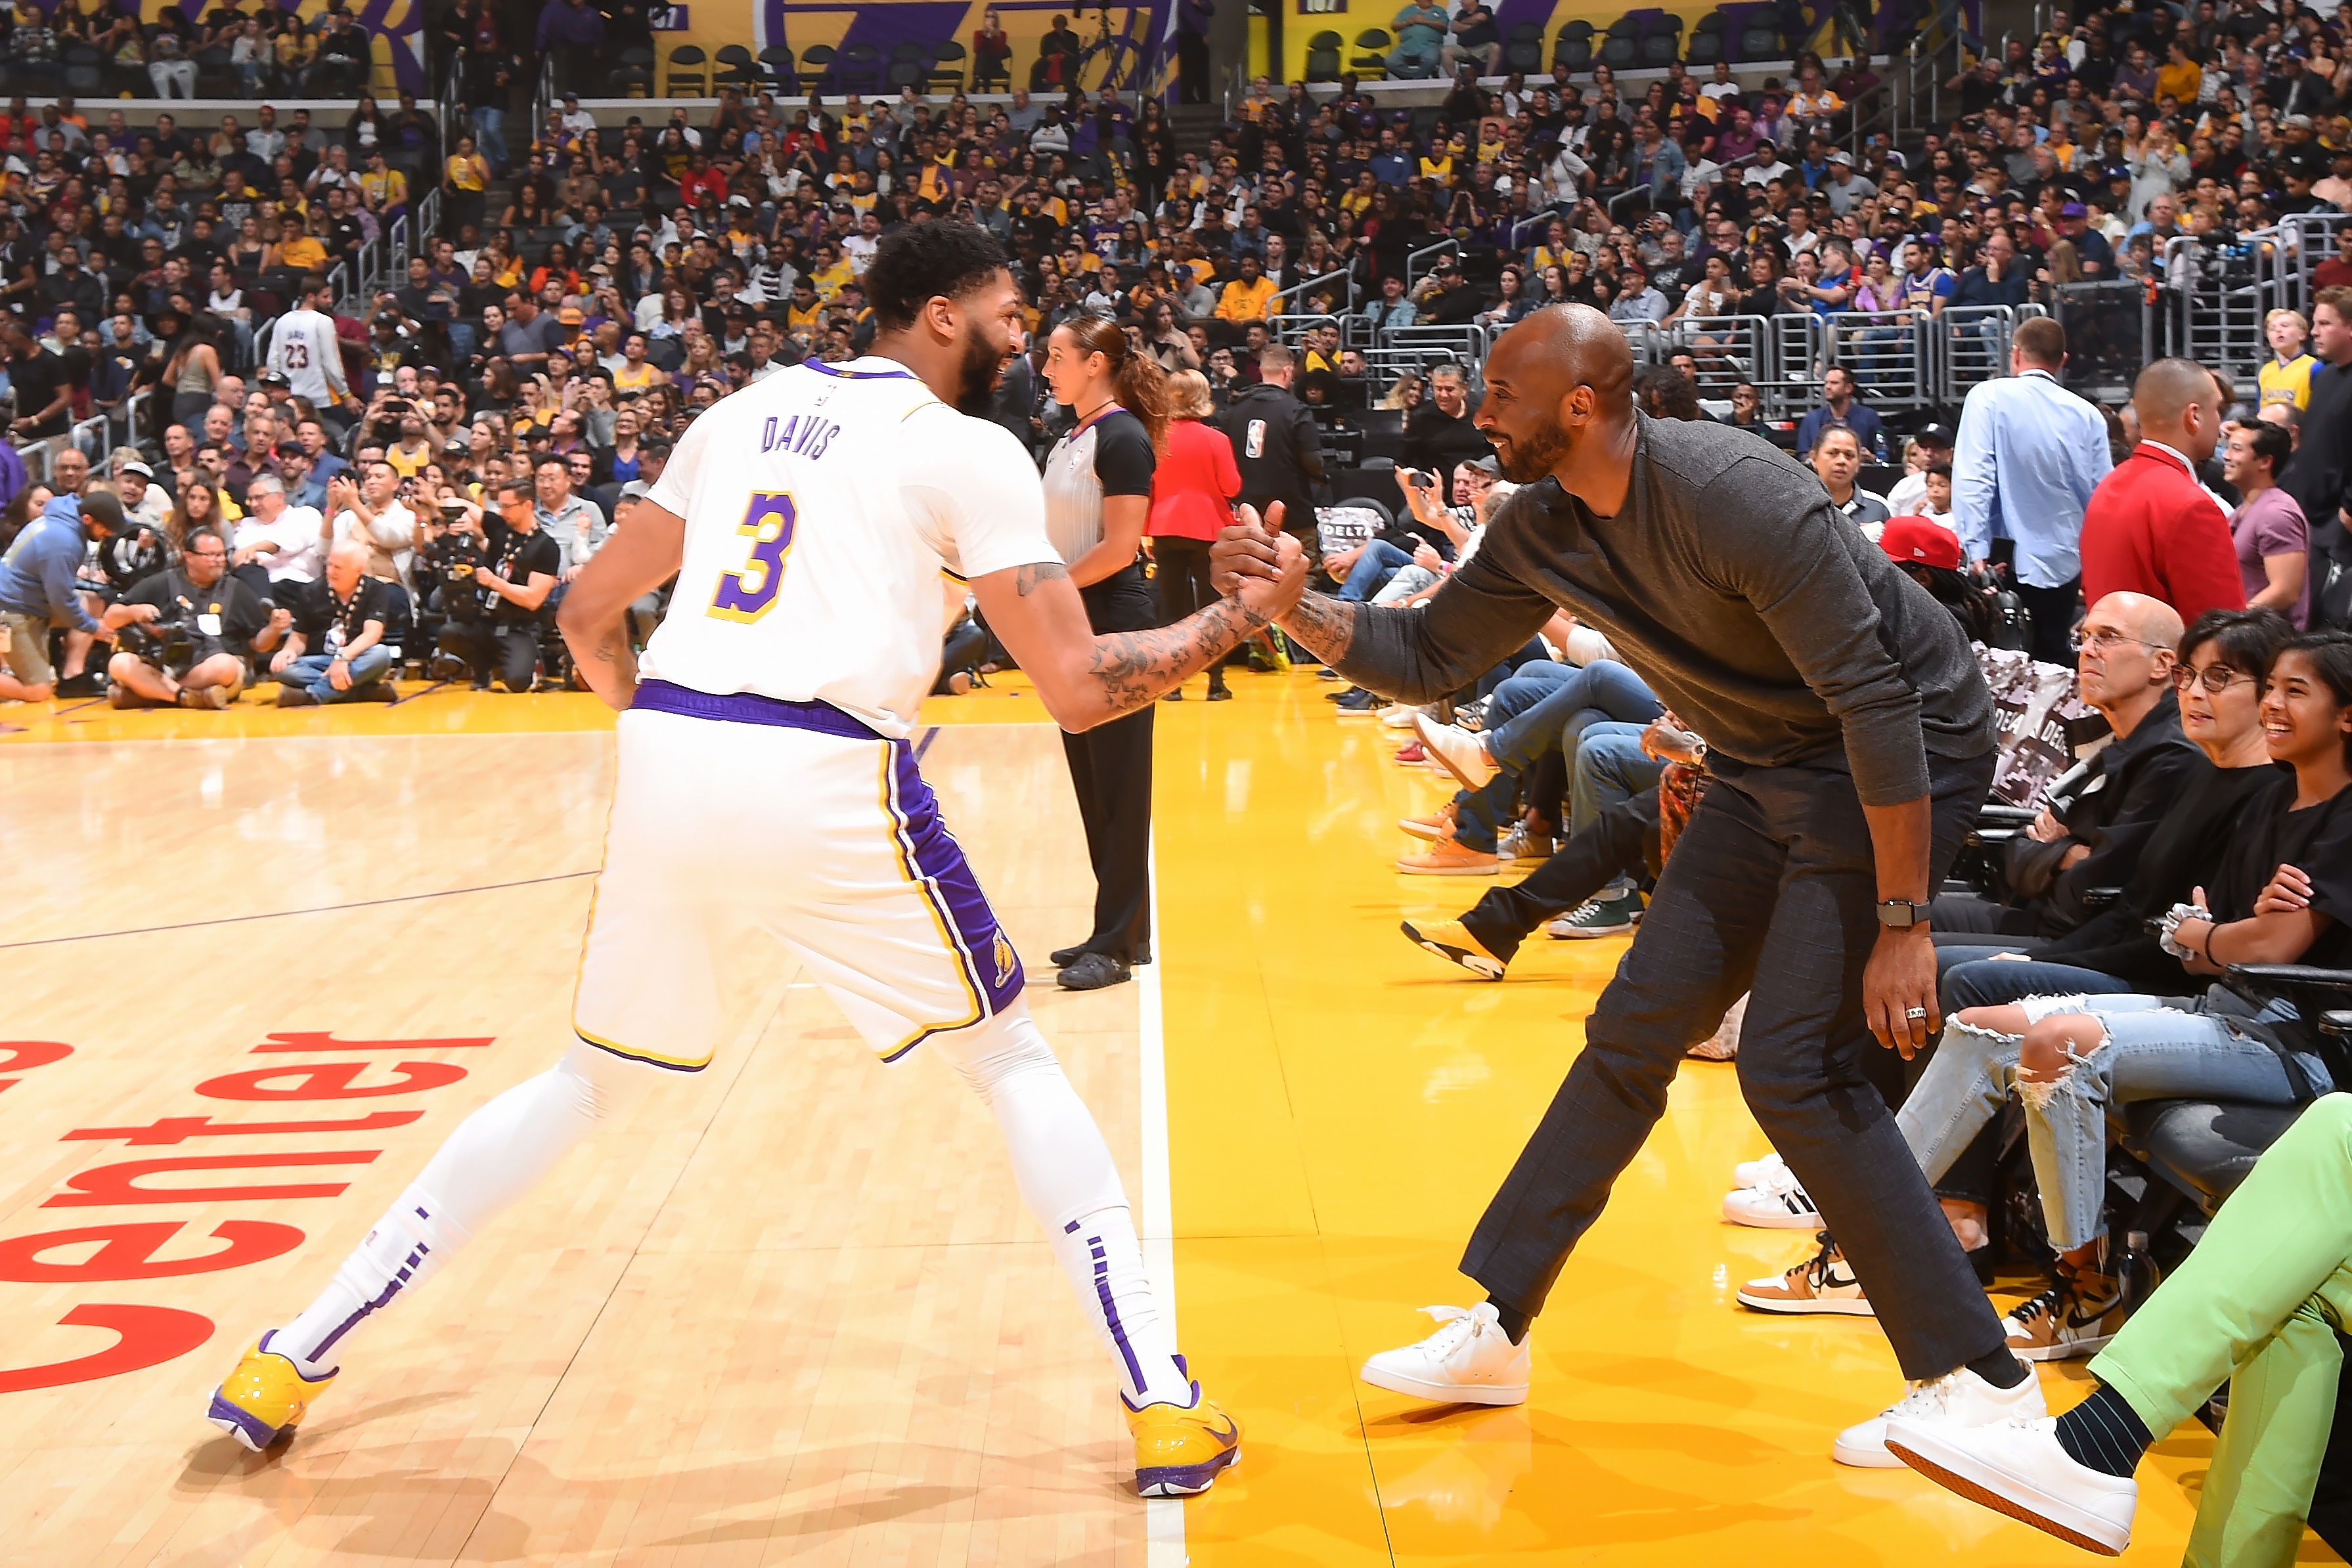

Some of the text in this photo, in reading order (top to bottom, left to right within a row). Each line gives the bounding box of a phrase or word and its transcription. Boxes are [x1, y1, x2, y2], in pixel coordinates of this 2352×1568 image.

[284, 342, 309, 370] 23
[761, 415, 840, 460] DAVIS
[1323, 525, 1373, 537] DELTA
[705, 490, 799, 624] 3
